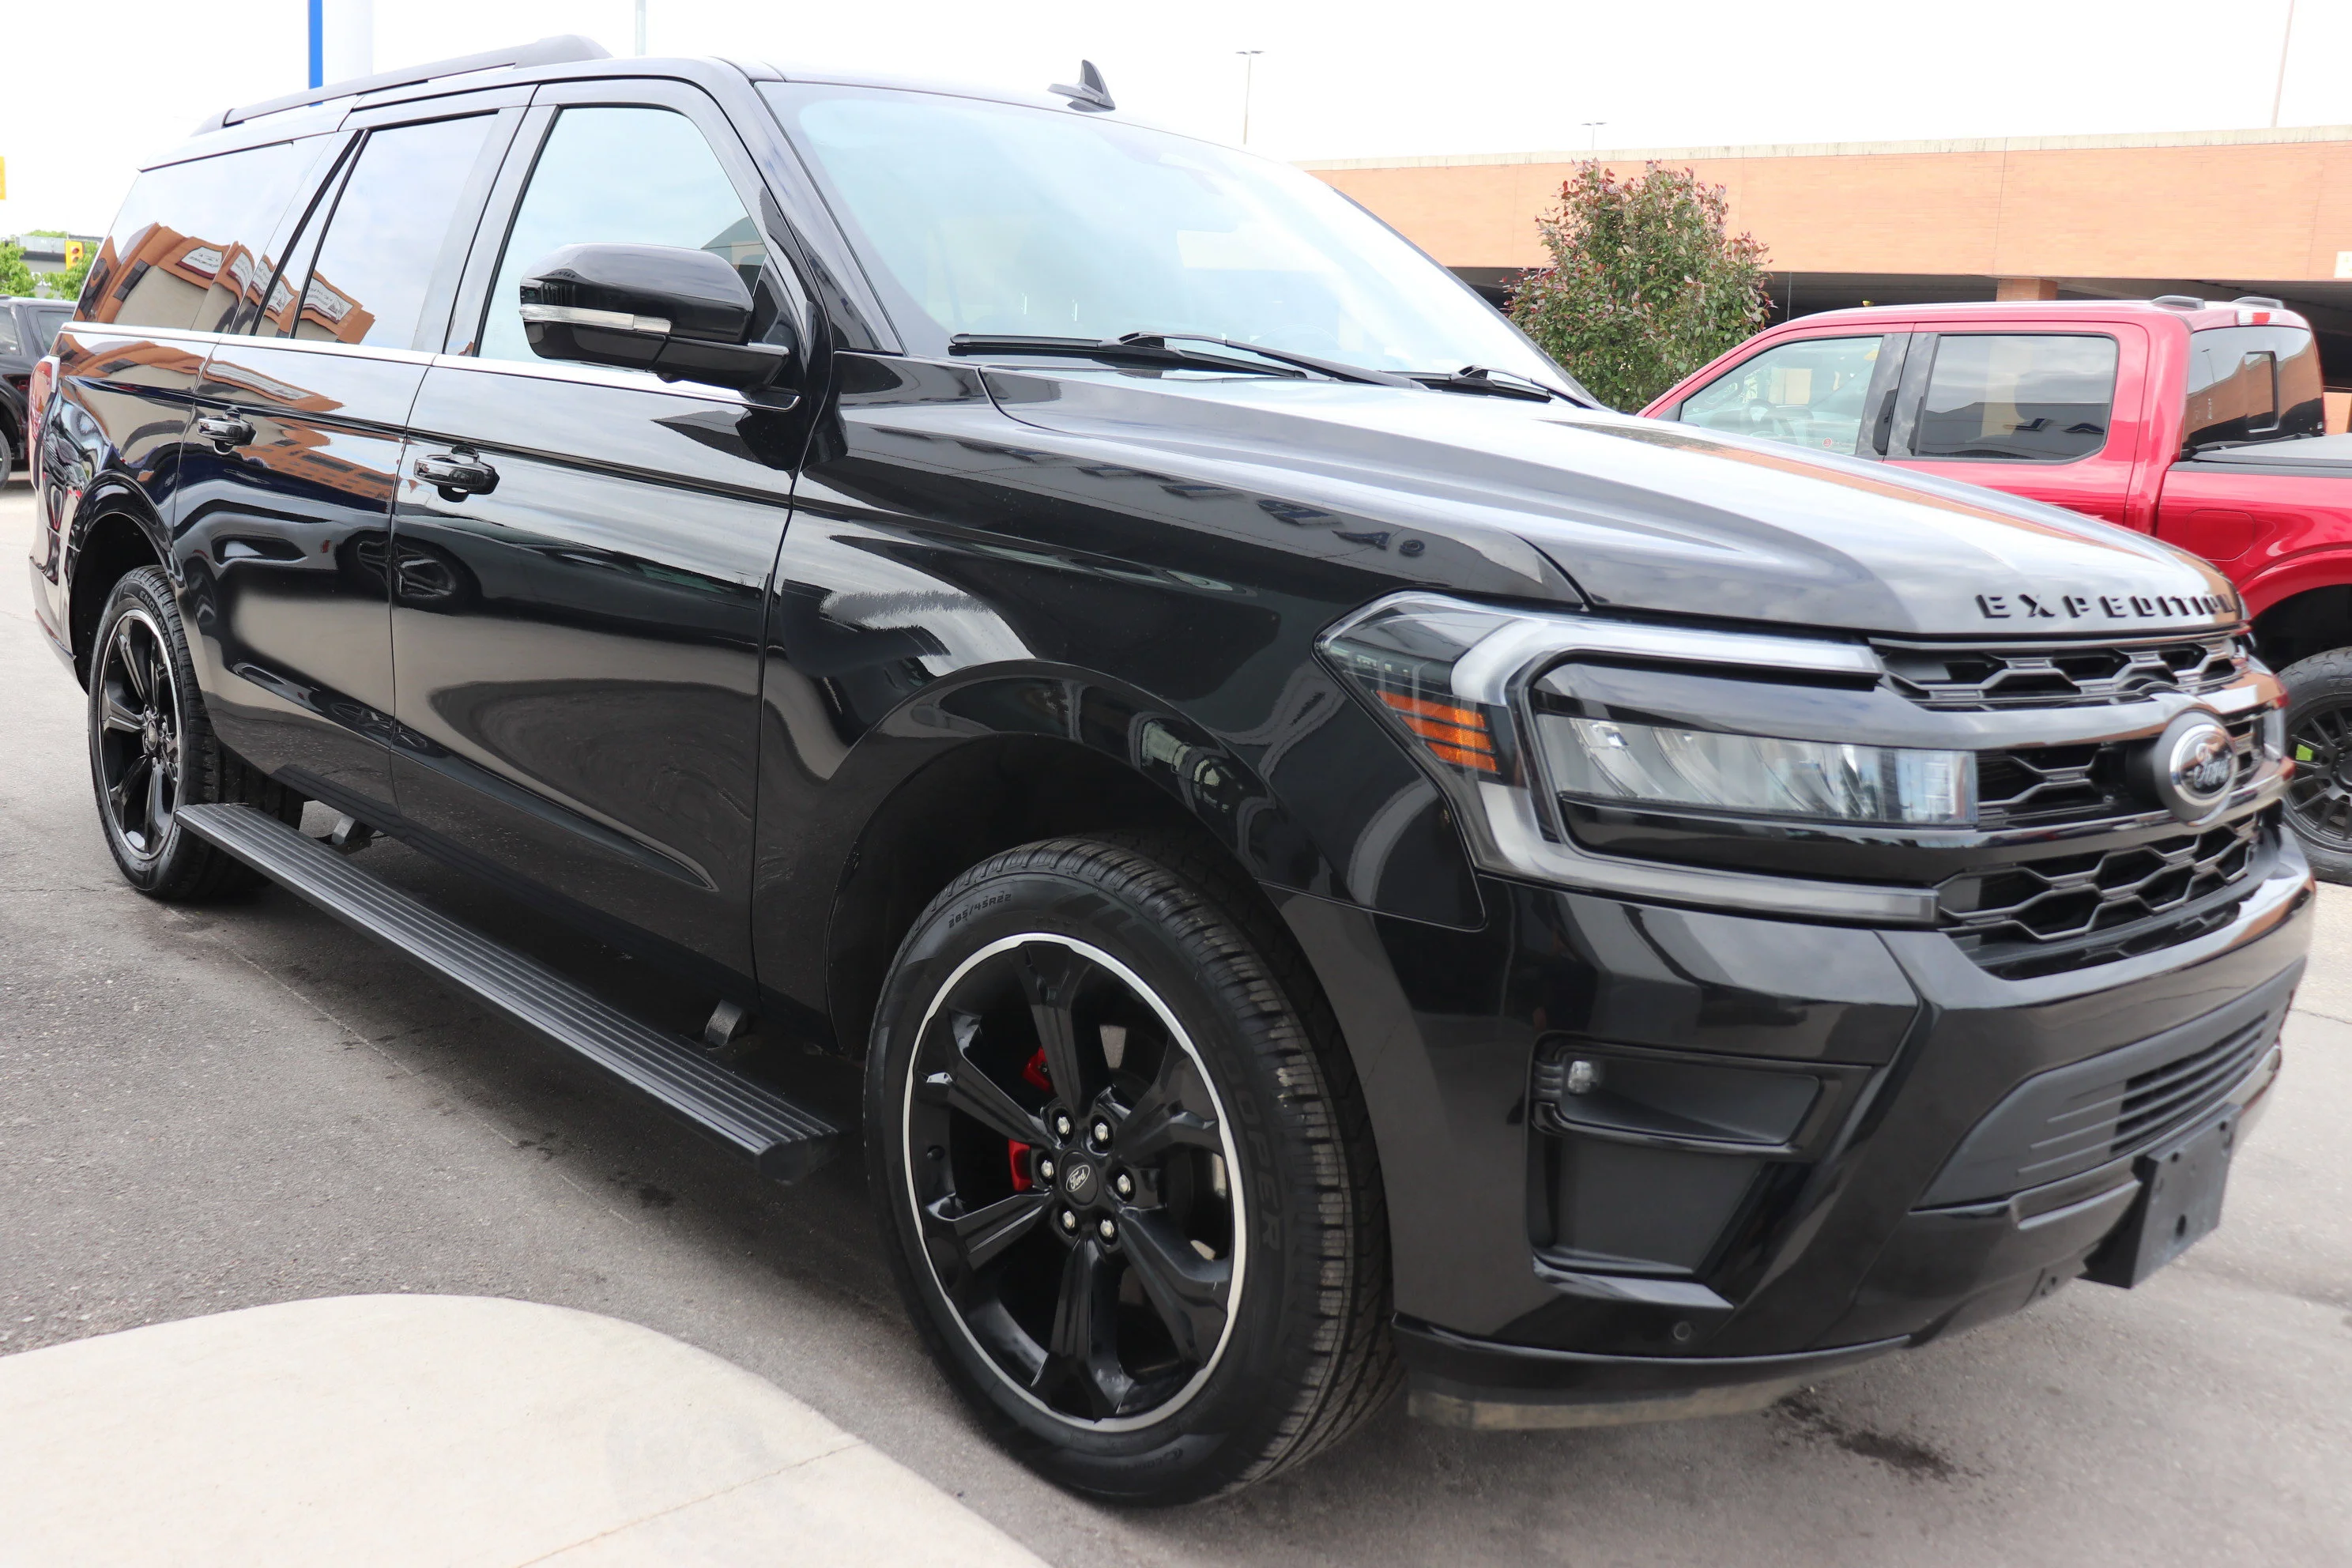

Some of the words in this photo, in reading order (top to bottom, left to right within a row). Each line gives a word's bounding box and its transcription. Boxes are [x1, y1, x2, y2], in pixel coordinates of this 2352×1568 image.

[139, 590, 175, 658] ENDEAVOR
[1974, 593, 2237, 620] EXPEDITION
[2186, 741, 2231, 789] Ford
[948, 893, 1012, 929] 285/45R22
[1199, 1016, 1282, 1252] COOPER
[1069, 1167, 1087, 1190] Ford
